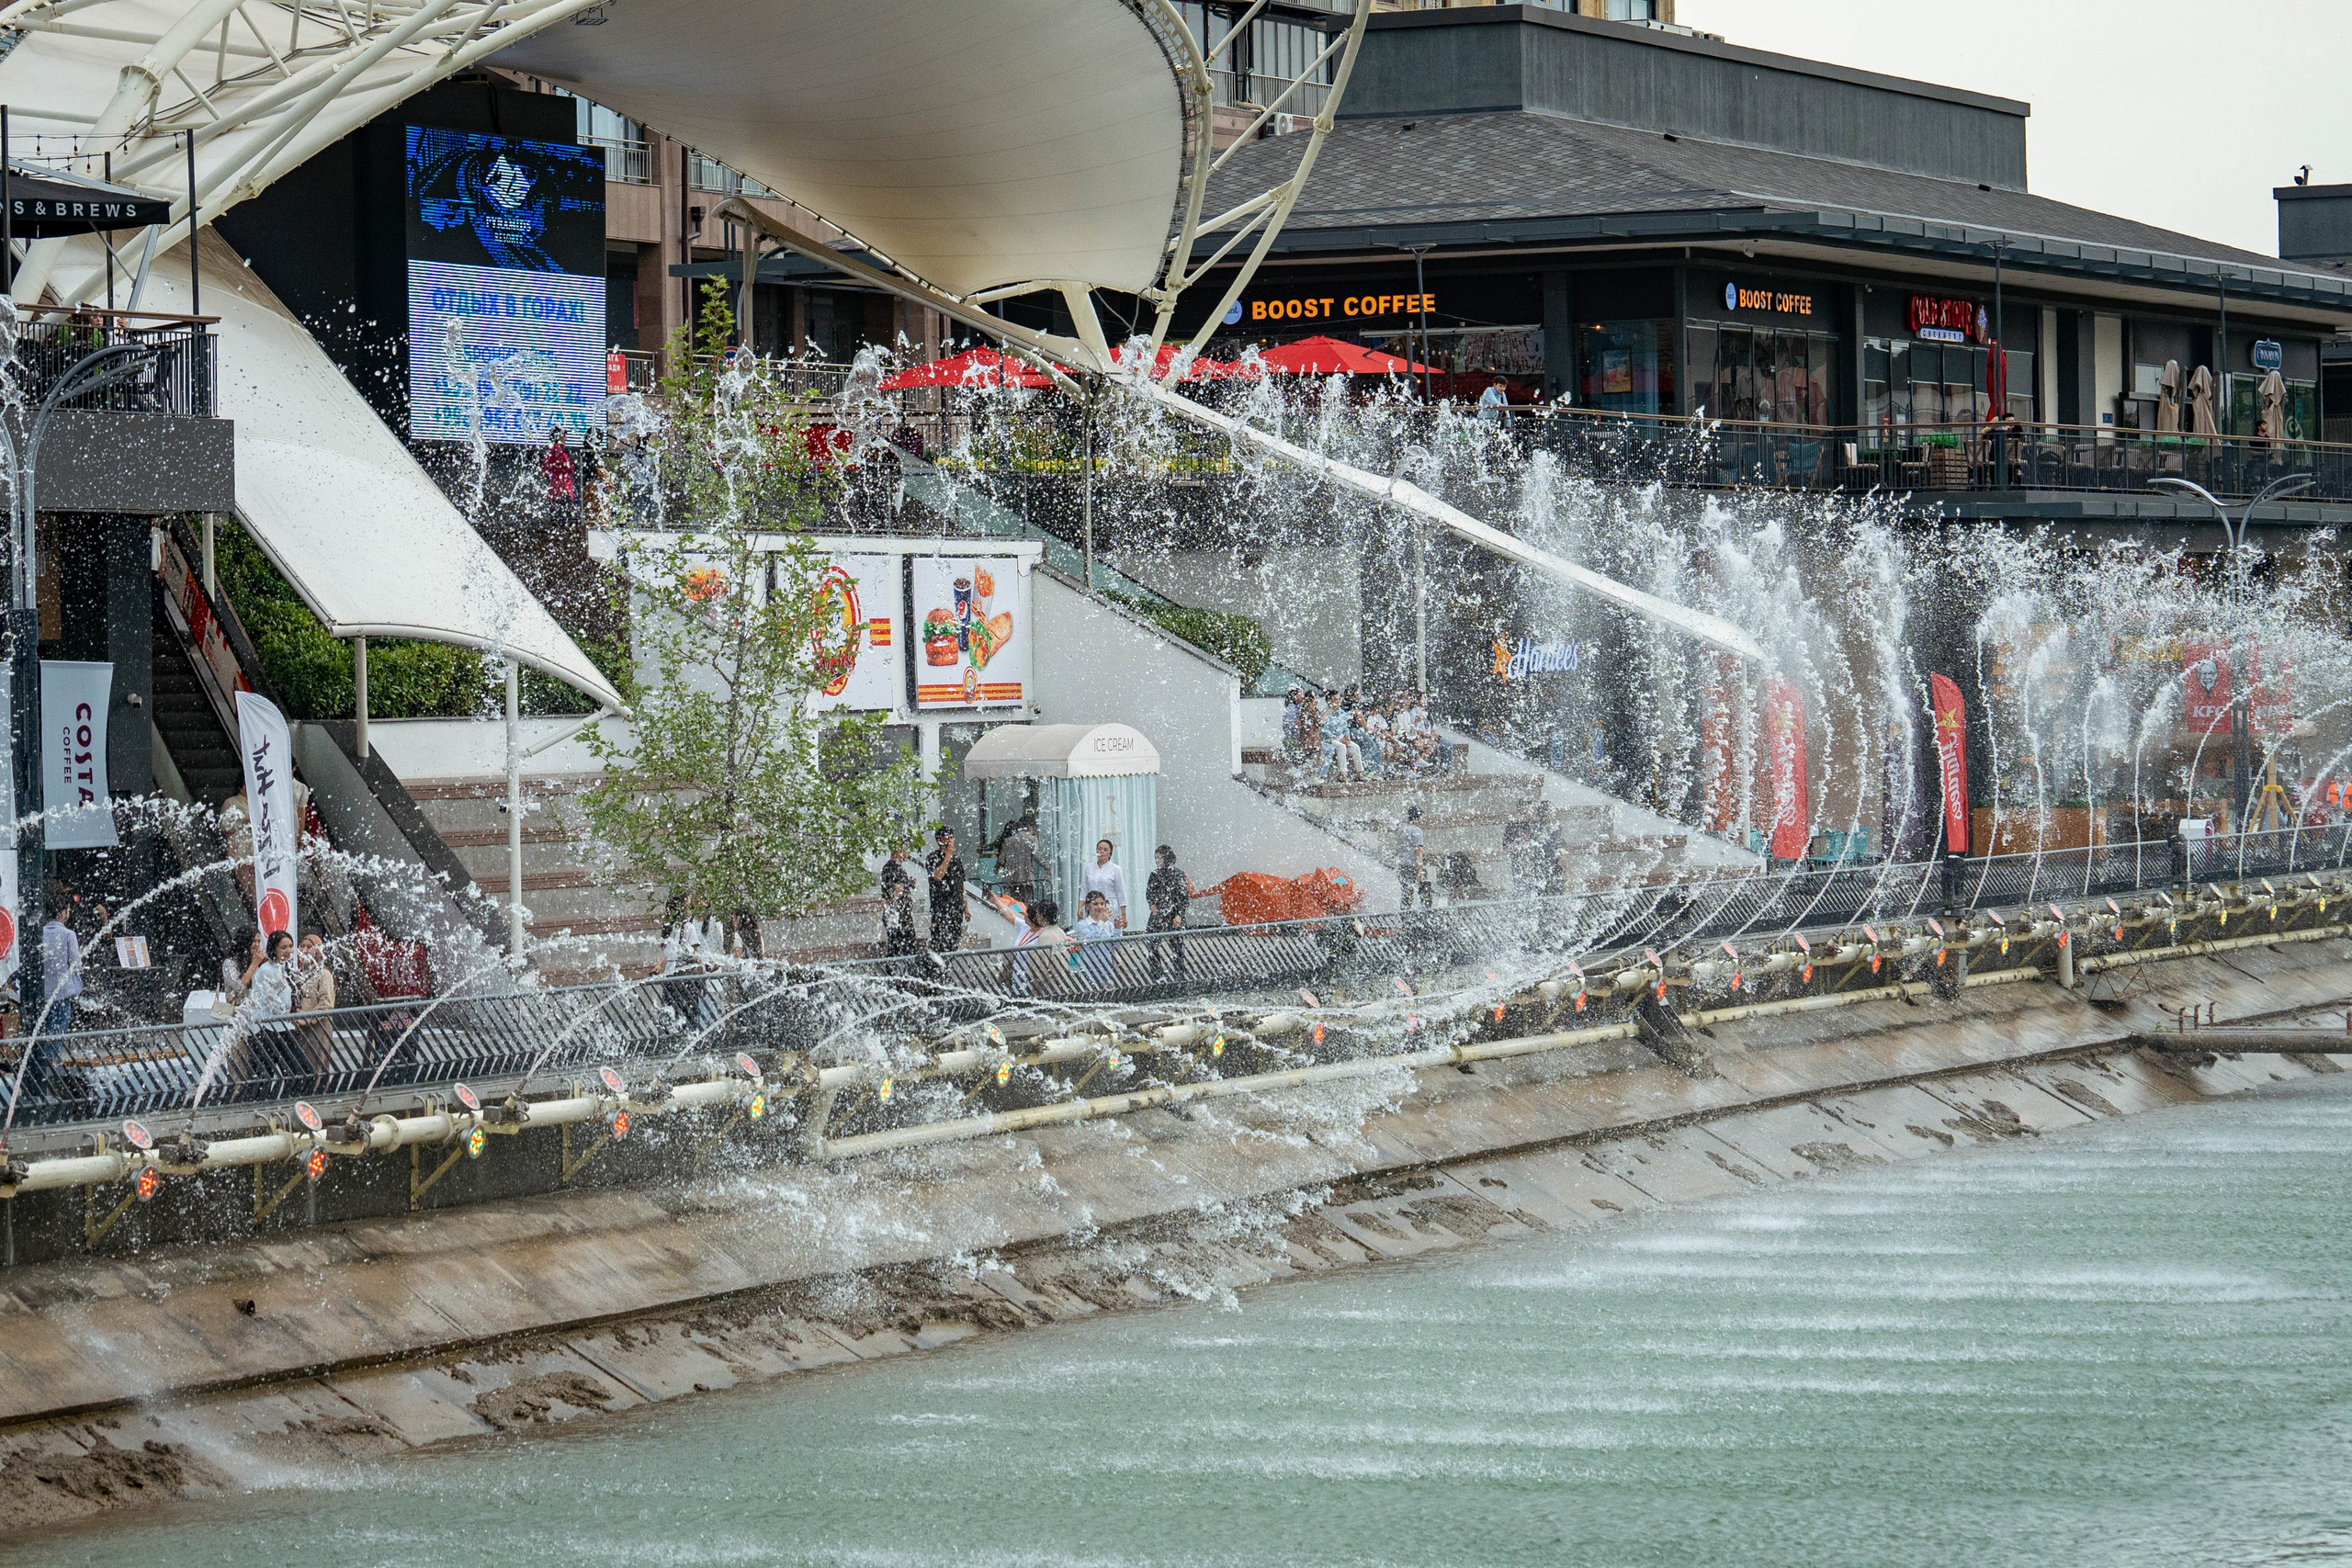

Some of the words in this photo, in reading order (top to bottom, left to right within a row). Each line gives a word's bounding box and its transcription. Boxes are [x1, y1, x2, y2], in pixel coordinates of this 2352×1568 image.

[35, 201, 46, 215] &
[55, 202, 137, 218] BREWS
[432, 288, 500, 316] ОТДЫХ
[505, 294, 516, 318] В
[523, 295, 585, 321] ГОРАХ!
[1251, 298, 1335, 321] BOOST
[1343, 293, 1436, 316] COFFEE
[1739, 288, 1773, 310] BOOST
[1776, 292, 1812, 315] COFFEE
[1939, 299, 1973, 337] STONE
[2192, 705, 2224, 718] KFC
[62, 726, 72, 784] COFFEE
[74, 702, 95, 808] COSTA
[1093, 738, 1106, 752] ICE
[1107, 737, 1135, 751] CREAM
